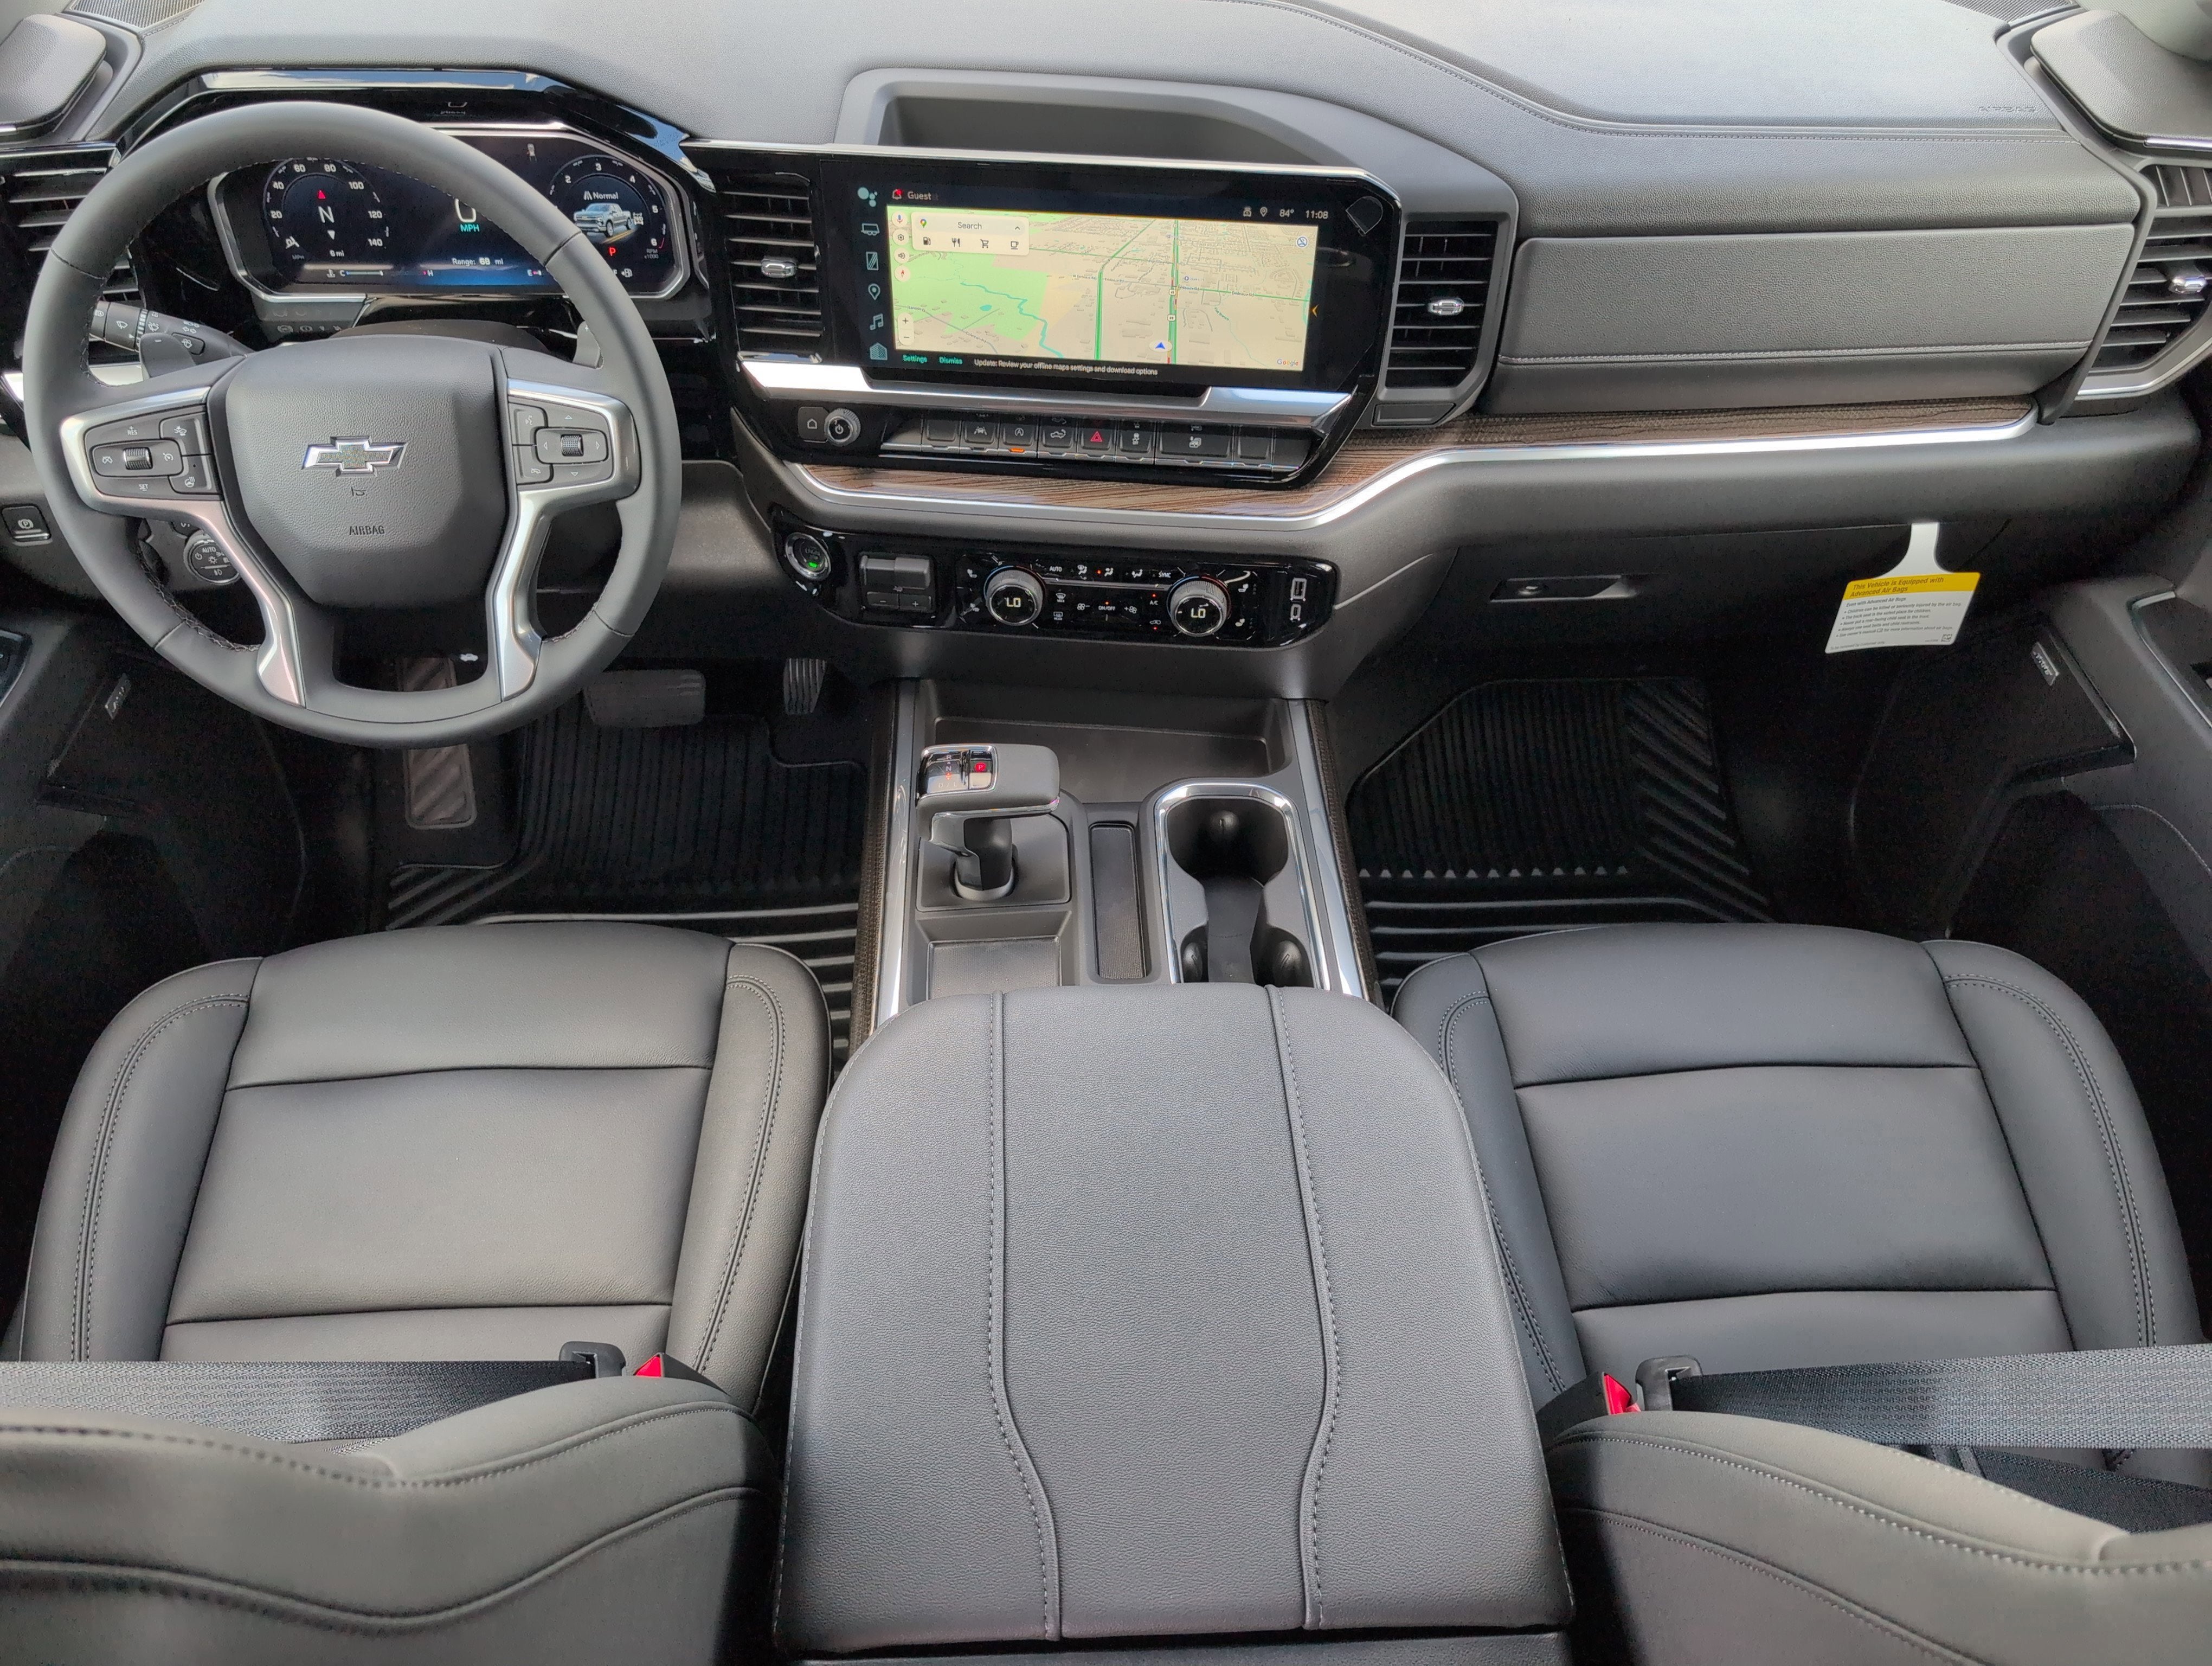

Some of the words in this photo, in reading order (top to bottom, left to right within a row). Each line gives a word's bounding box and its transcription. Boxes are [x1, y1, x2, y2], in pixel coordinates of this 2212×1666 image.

[293, 164, 306, 172] 60
[324, 164, 337, 172] 80
[565, 175, 571, 183] 2
[629, 175, 636, 183] 4
[273, 182, 285, 190] 40
[349, 182, 364, 190] 100
[593, 191, 619, 200] Normal
[907, 191, 931, 201] Guest
[652, 205, 659, 214] 5
[271, 210, 283, 219] 20
[318, 206, 335, 223] N
[368, 210, 383, 219] 120
[1306, 210, 1329, 219] 11:08
[460, 223, 480, 232] MPH
[957, 222, 982, 230] Search
[368, 239, 383, 247] 140
[651, 238, 658, 246] 6
[608, 247, 616, 257] P
[451, 257, 476, 266] Range:
[902, 354, 928, 364] Settings
[939, 356, 963, 365] Dismiss
[1277, 358, 1299, 367] Google
[974, 358, 998, 367] Update:
[998, 360, 1019, 368] Review
[1033, 362, 1052, 370] offline
[1053, 363, 1070, 372] maps
[1070, 364, 1094, 373] settings
[1107, 366, 1135, 374] download
[1136, 368, 1158, 376] options
[349, 525, 385, 535] AIRBAG
[1898, 578, 1928, 586] Equipped
[1850, 588, 1880, 597] Advanced
[1006, 597, 1021, 608] LO
[1191, 607, 1206, 619] LO
